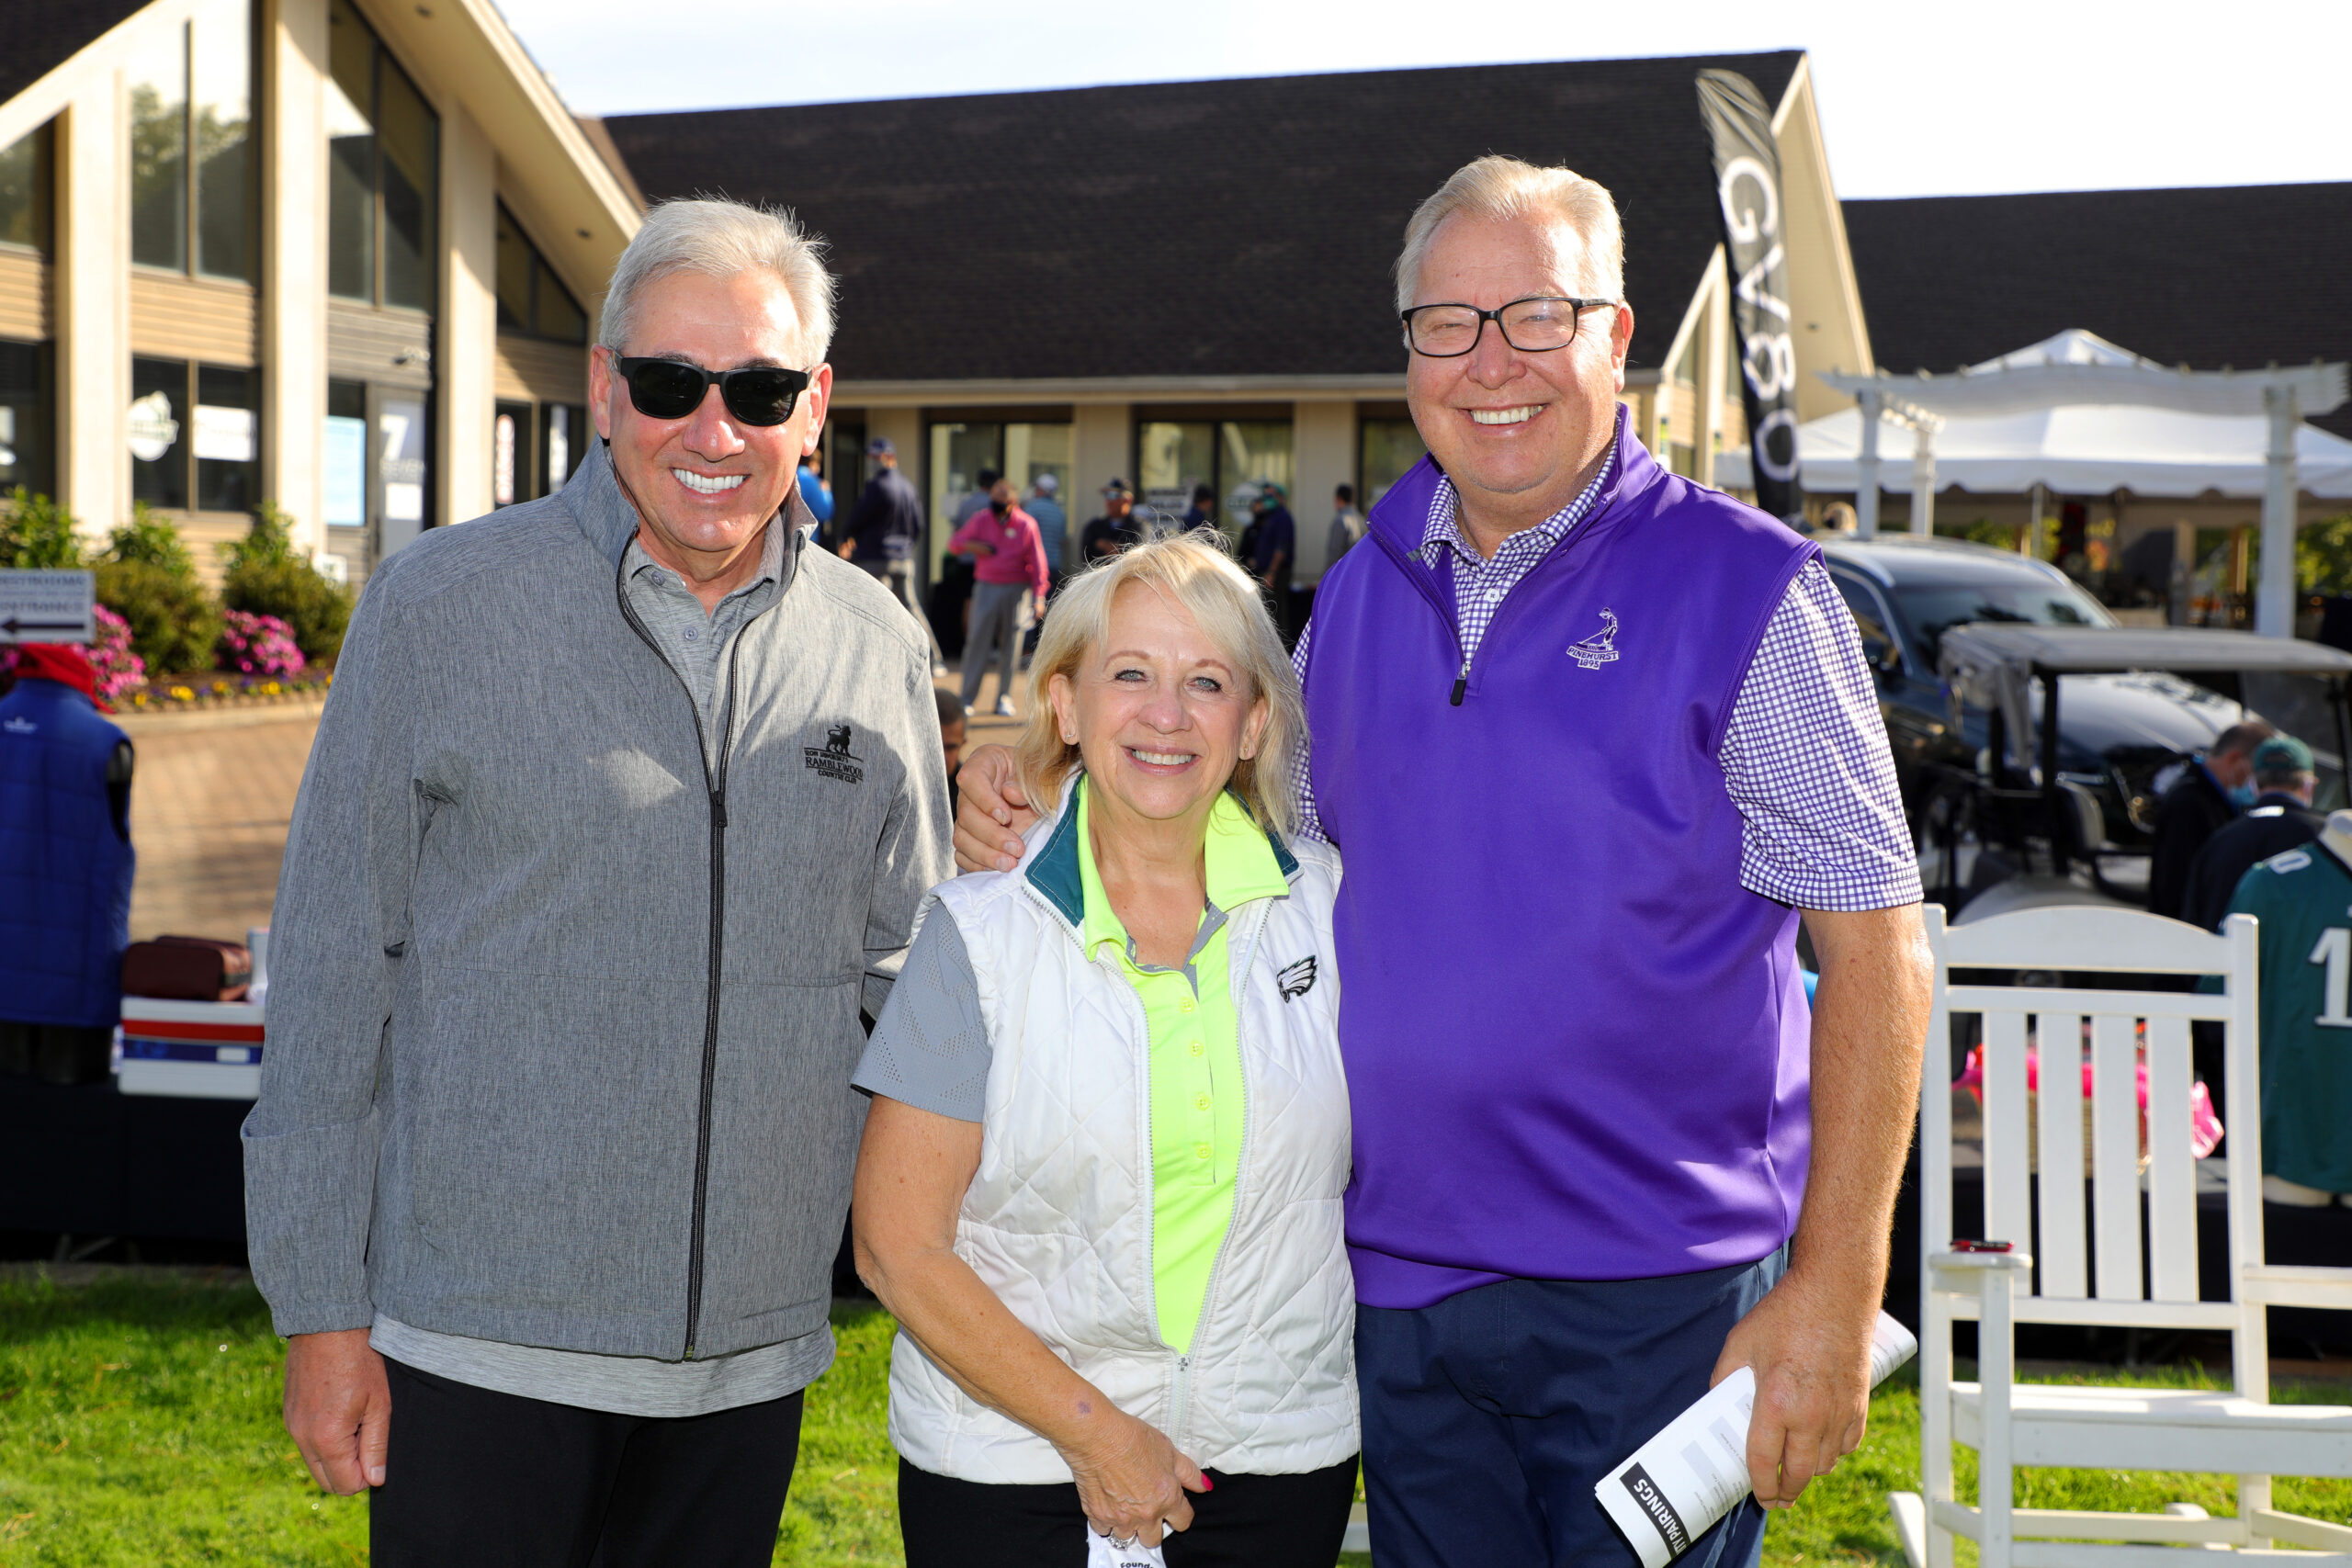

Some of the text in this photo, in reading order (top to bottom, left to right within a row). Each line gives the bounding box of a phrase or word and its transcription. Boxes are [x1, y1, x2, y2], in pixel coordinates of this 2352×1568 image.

[1717, 155, 1798, 482] GV80
[1567, 647, 1617, 660] PINEHURST
[1578, 658, 1600, 669] 1895
[806, 756, 864, 778] RAMBLEWOOD
[1634, 1478, 1681, 1541] PAIRINGS
